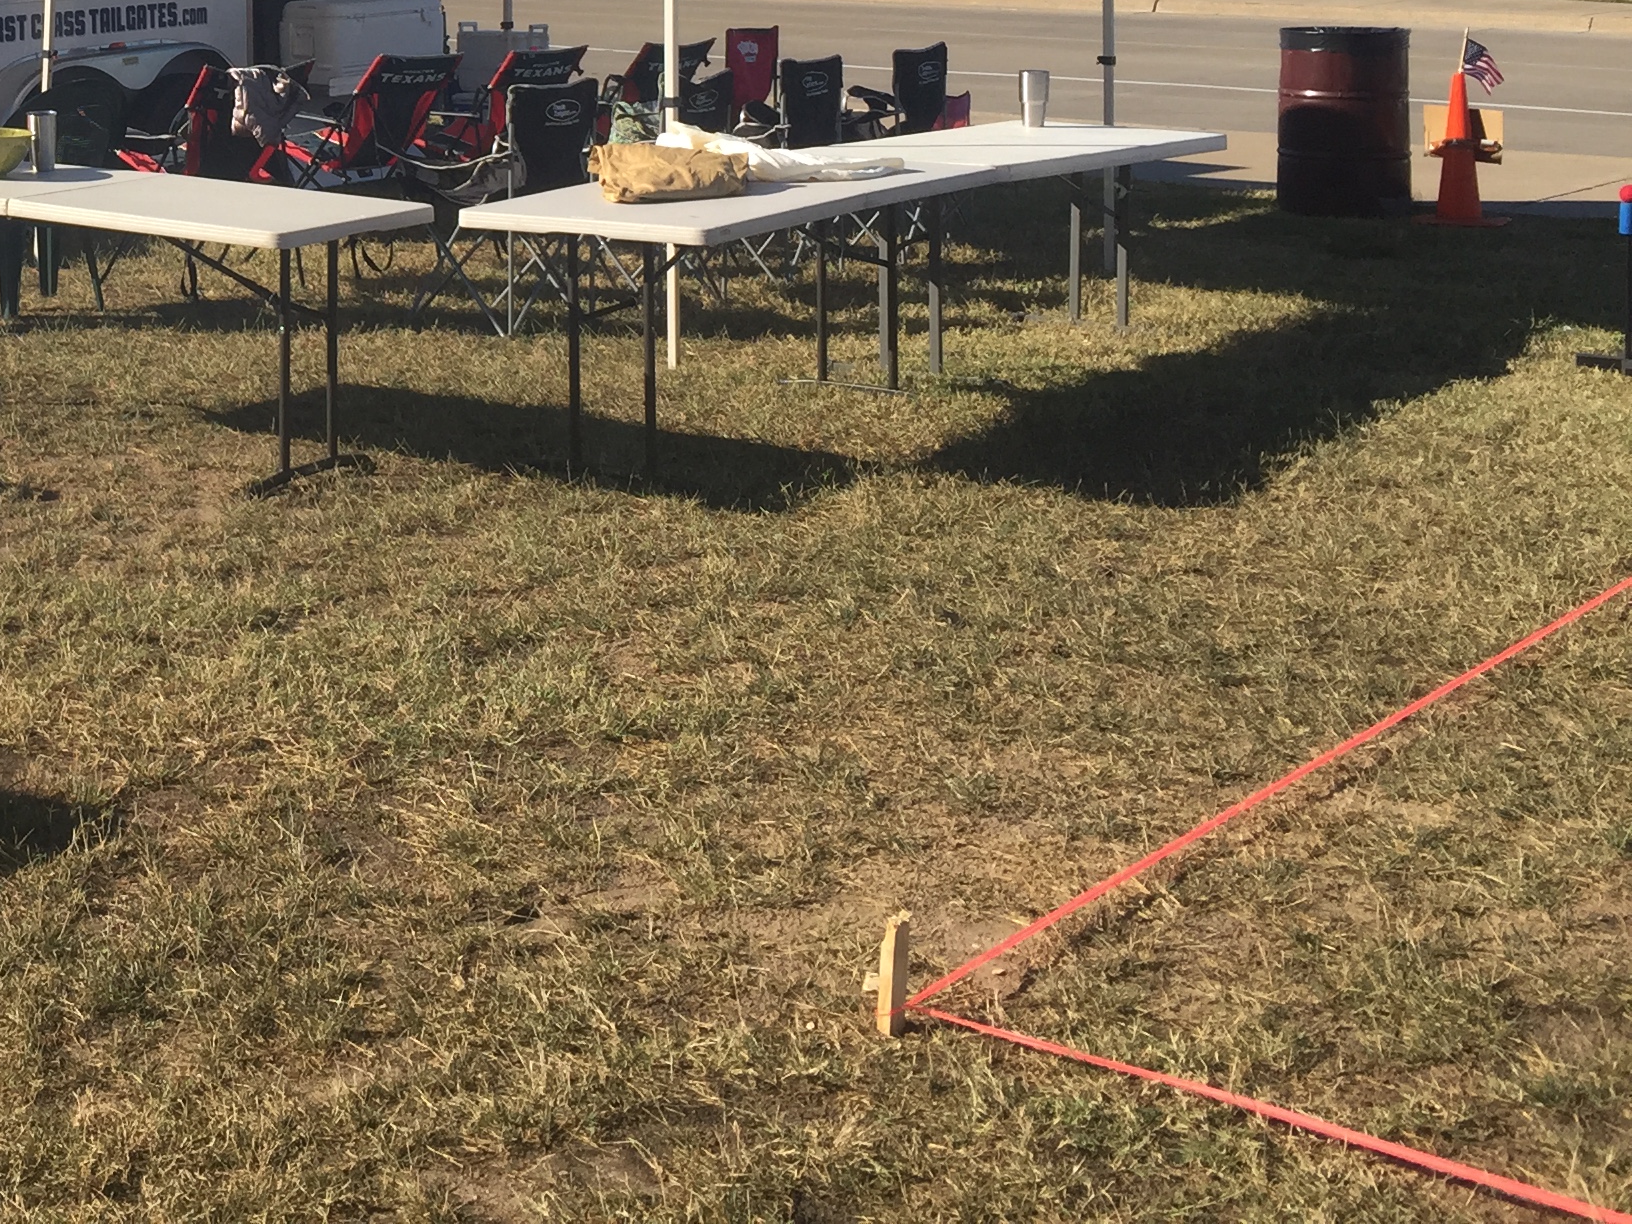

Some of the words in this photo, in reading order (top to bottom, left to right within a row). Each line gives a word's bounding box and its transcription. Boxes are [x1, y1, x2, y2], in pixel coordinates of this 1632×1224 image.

[30, 9, 86, 39] CASS
[88, 2, 208, 35] TAILGATES.com
[514, 65, 572, 78] TEXANS
[380, 73, 446, 84] TEXANS
